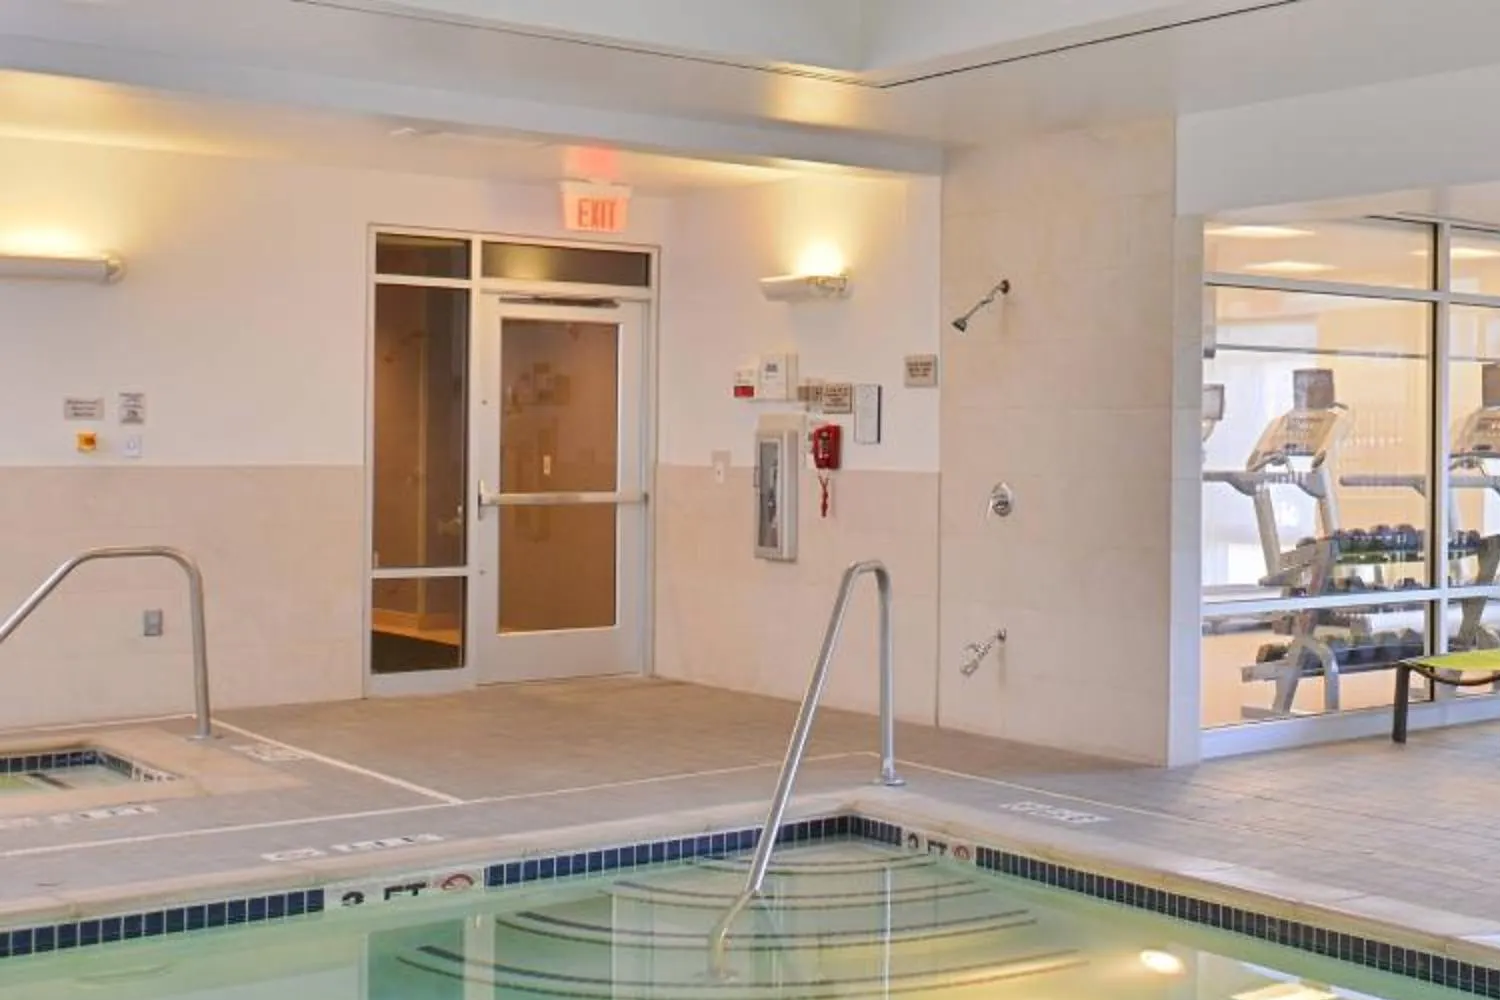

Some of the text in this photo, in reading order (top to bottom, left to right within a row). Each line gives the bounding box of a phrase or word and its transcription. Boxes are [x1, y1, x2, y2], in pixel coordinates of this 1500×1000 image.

[578, 198, 616, 229] EXIT
[927, 839, 948, 857] FT
[384, 882, 427, 901] FT
